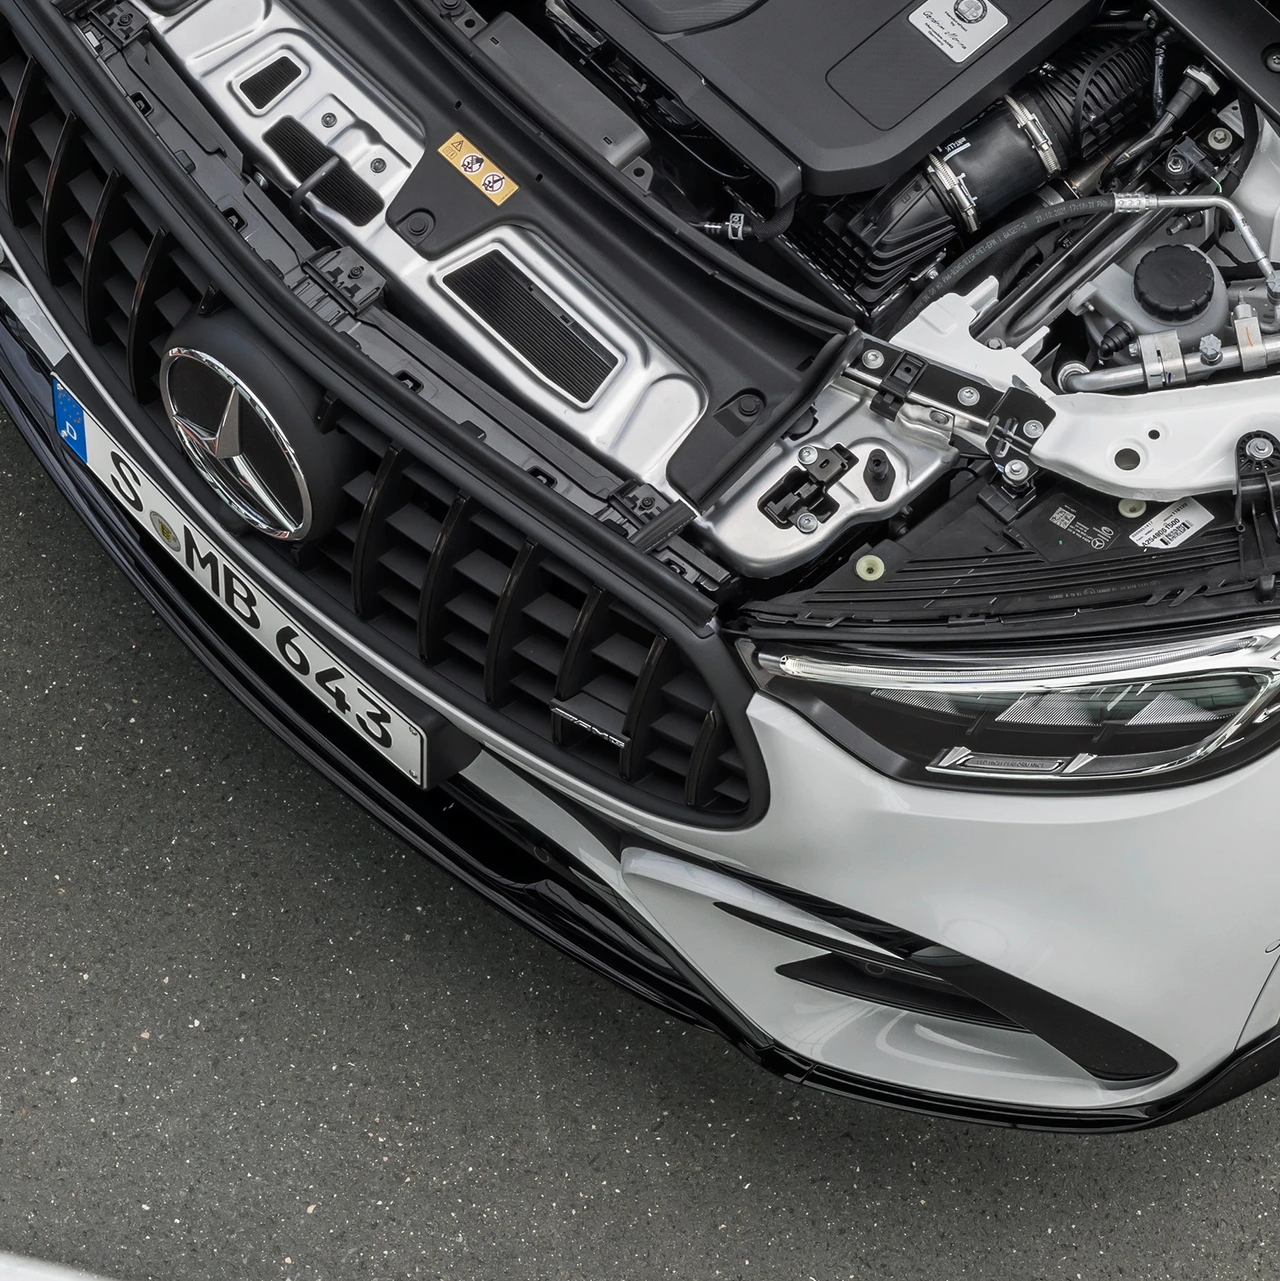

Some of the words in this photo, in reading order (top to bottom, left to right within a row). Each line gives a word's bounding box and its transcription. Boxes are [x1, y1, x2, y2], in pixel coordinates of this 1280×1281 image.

[66, 421, 77, 440] D
[111, 450, 143, 511] S
[185, 523, 261, 630] MB
[275, 625, 392, 749] 643
